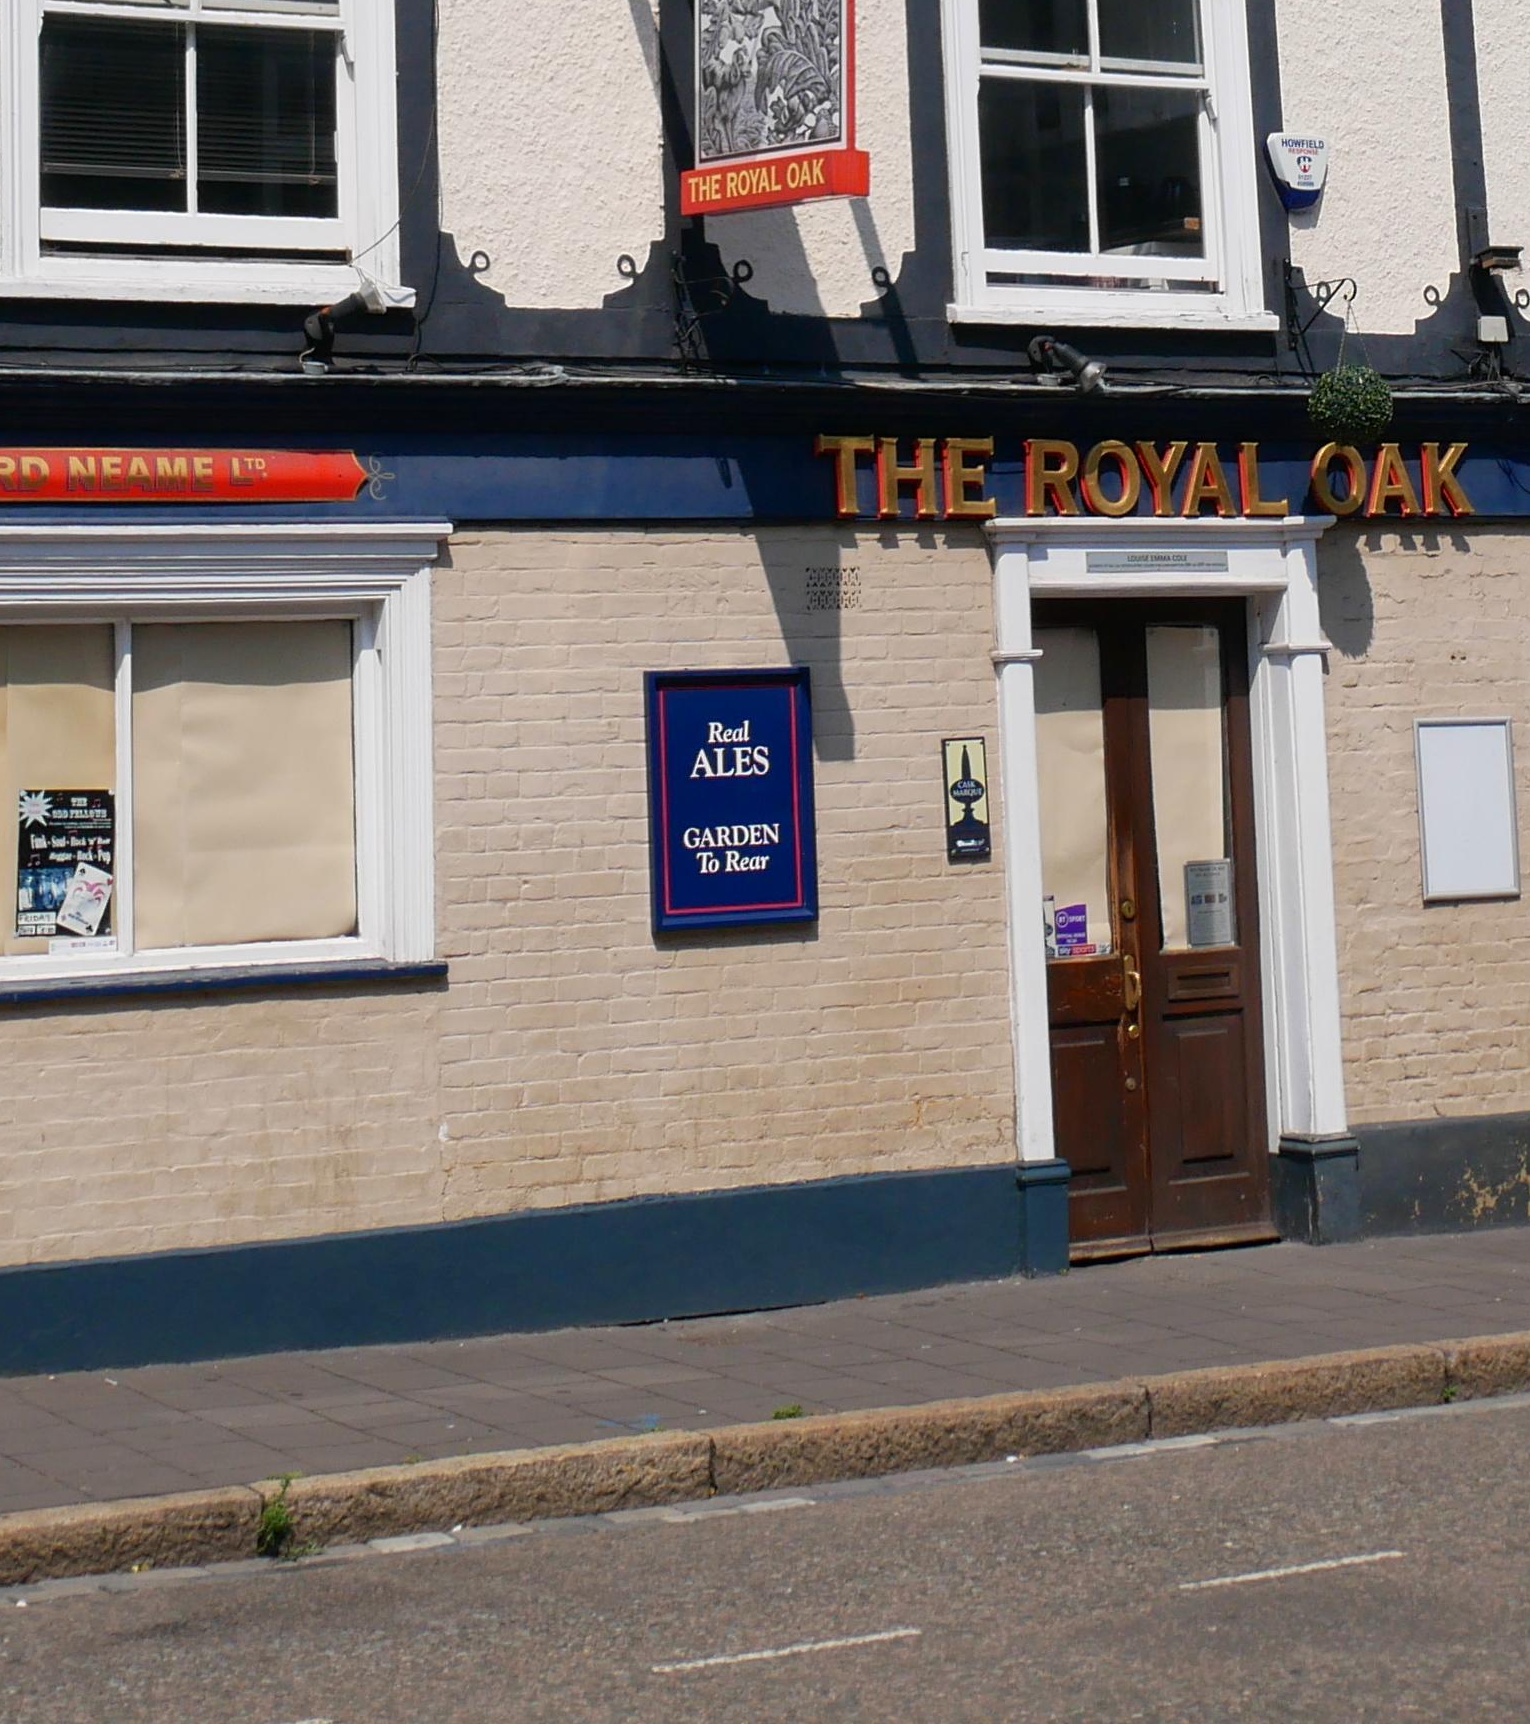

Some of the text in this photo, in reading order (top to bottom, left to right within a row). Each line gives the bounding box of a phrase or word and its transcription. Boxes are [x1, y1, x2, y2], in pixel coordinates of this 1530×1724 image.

[1281, 138, 1325, 149] HOWFIELD
[687, 158, 825, 204] THE ROYAL OAK
[69, 456, 214, 493] NEAME
[814, 434, 1474, 519] THE ROYAL OAK
[708, 720, 750, 744] Real
[690, 745, 770, 778] ALES
[683, 823, 780, 849] GARDEN
[696, 851, 770, 874] To Rear
